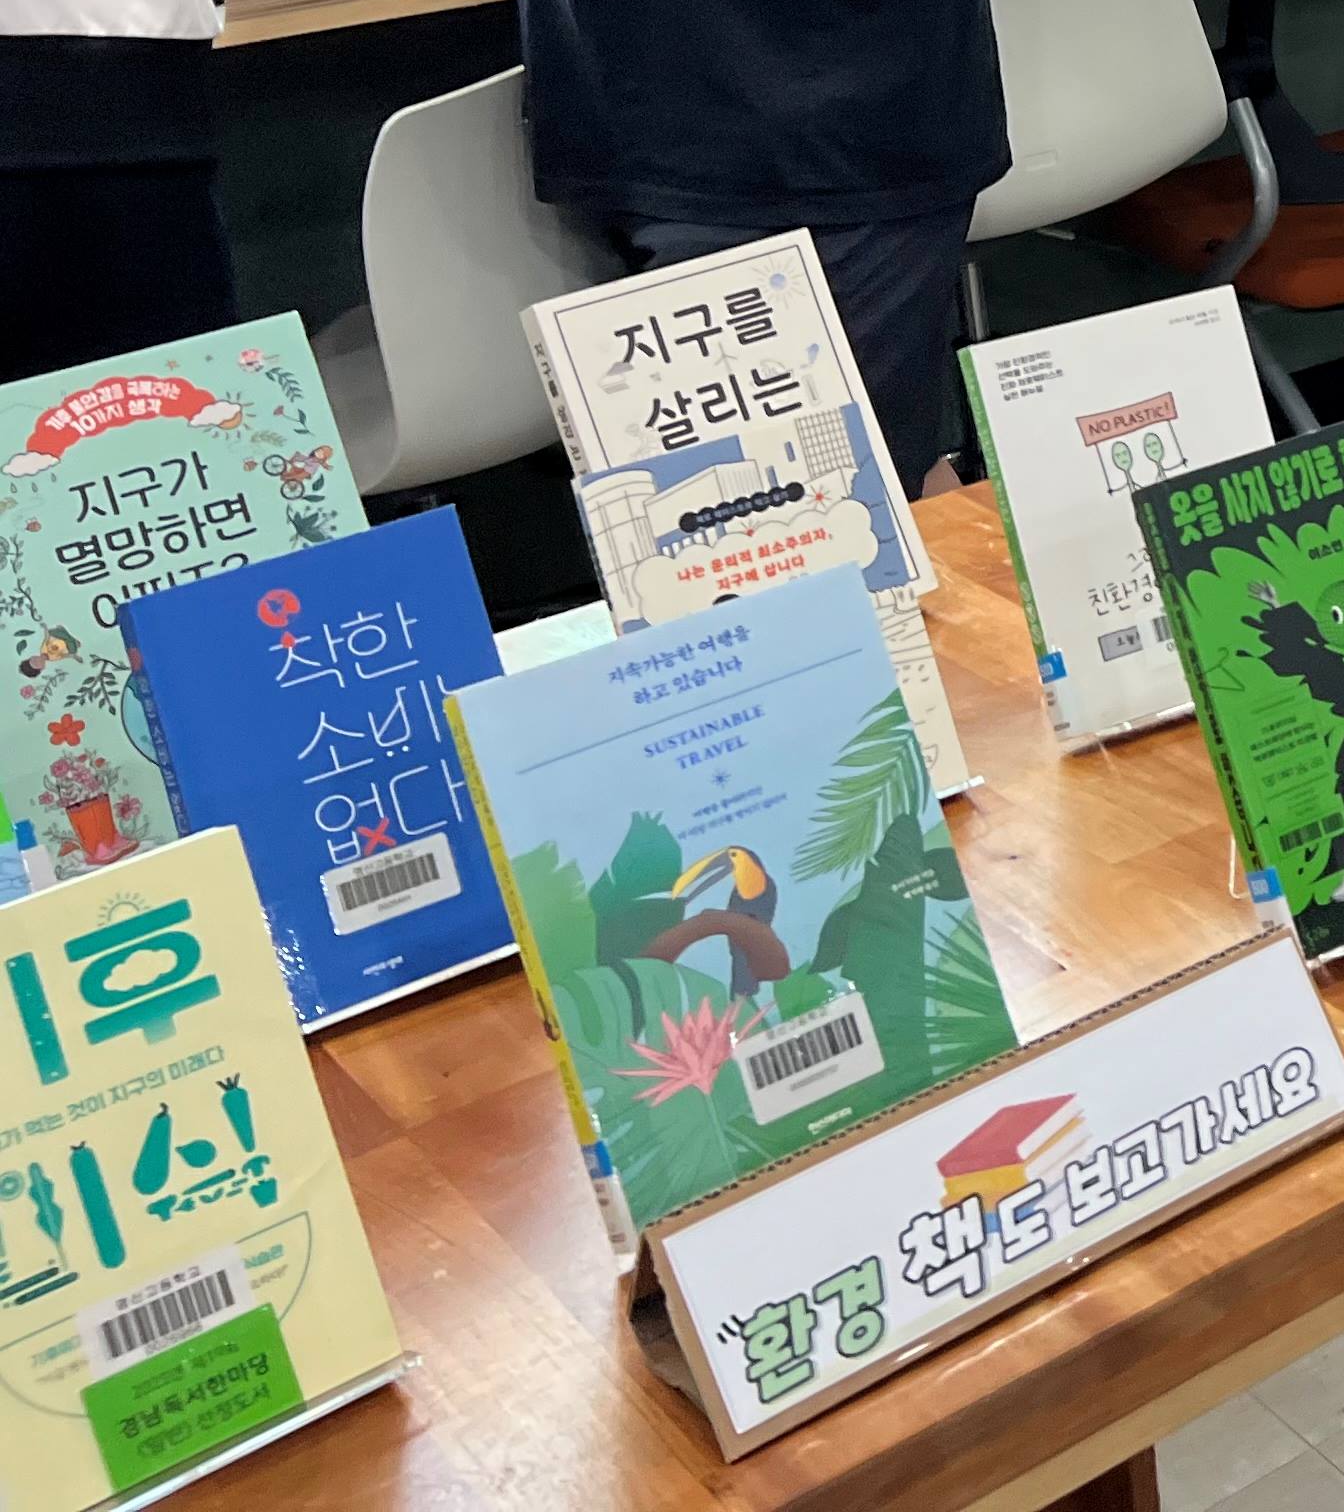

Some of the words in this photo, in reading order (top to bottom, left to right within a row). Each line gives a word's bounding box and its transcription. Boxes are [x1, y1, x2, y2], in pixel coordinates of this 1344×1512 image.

[614, 287, 777, 364] 지구를
[70, 403, 125, 436] 10가지
[645, 369, 803, 451] 살리는
[1087, 418, 1111, 437] NO
[1112, 401, 1170, 430] PLASTIC!
[69, 450, 208, 523] 지구가
[1169, 483, 1224, 546] 옷을
[1219, 465, 1275, 526] 사지
[1268, 444, 1344, 512] 않기로
[55, 493, 257, 586] 멸망하면
[677, 565, 706, 582] 나는
[269, 602, 418, 688] 착한
[608, 642, 695, 684] 지속가능한
[697, 624, 751, 653] 여행을
[633, 683, 671, 705] 하고
[672, 656, 743, 693] 있습니다
[644, 704, 766, 758] SUSTAINABLE
[675, 735, 750, 770] TRAVEL
[315, 759, 464, 865] 없다
[66, 1092, 106, 1120] 것이
[108, 1067, 166, 1106] 지구의
[167, 1045, 225, 1081] 미래다
[742, 1256, 885, 1404] 환경
